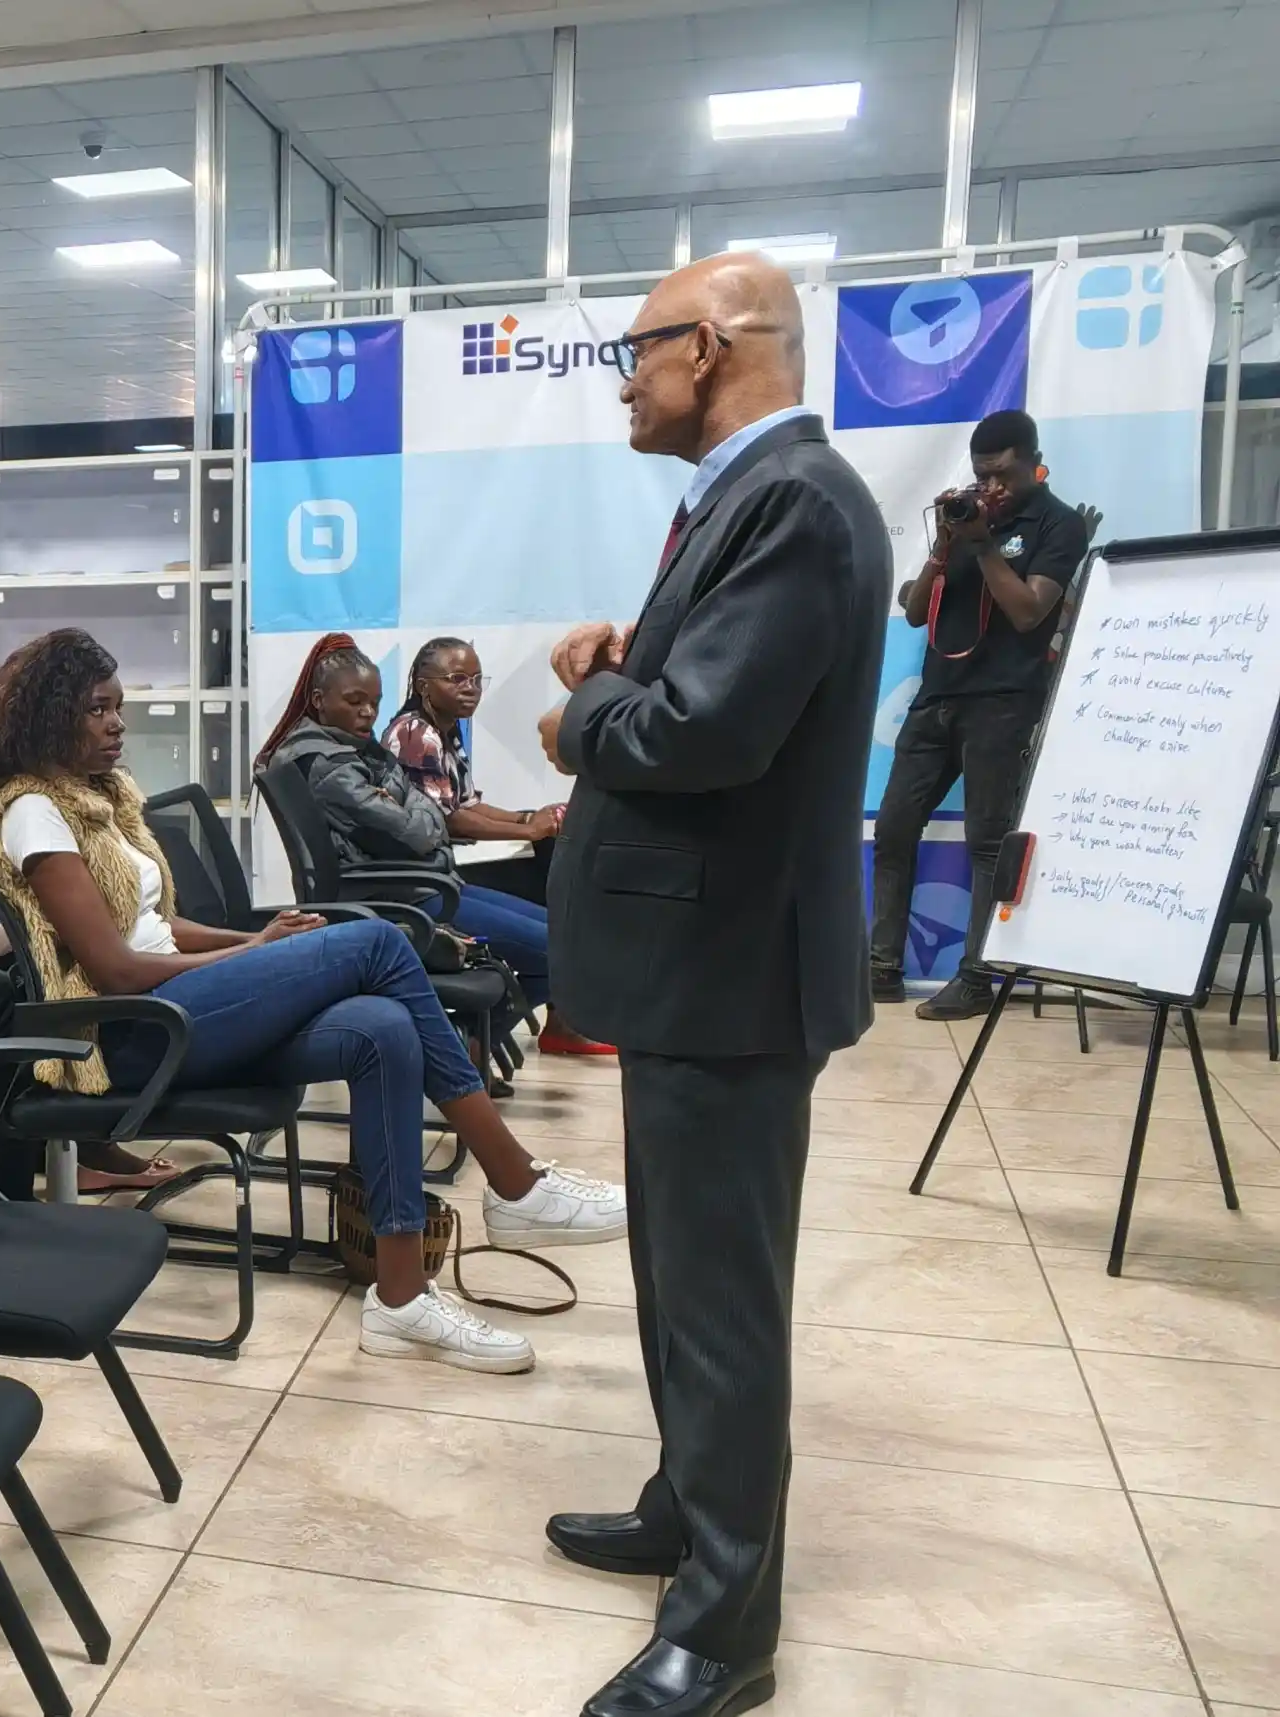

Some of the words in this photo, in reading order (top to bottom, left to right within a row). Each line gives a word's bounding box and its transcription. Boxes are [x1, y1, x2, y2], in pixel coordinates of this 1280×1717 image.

[1113, 618, 1140, 631] Own
[1148, 610, 1202, 630] mistakes
[1209, 603, 1270, 638] quickly
[1191, 644, 1254, 673] proactively
[1146, 679, 1183, 691] excuse
[1187, 679, 1235, 699] culture
[1160, 714, 1187, 736] early
[1191, 717, 1223, 733] when
[1160, 741, 1190, 752] arise
[1072, 788, 1096, 804] What
[1071, 808, 1094, 824] What
[1099, 816, 1115, 827] are
[1119, 820, 1136, 834] you
[1177, 821, 1198, 841] for
[1070, 828, 1086, 849] Why
[1090, 837, 1111, 850] your
[1116, 838, 1141, 851] work
[1145, 843, 1184, 860] matters
